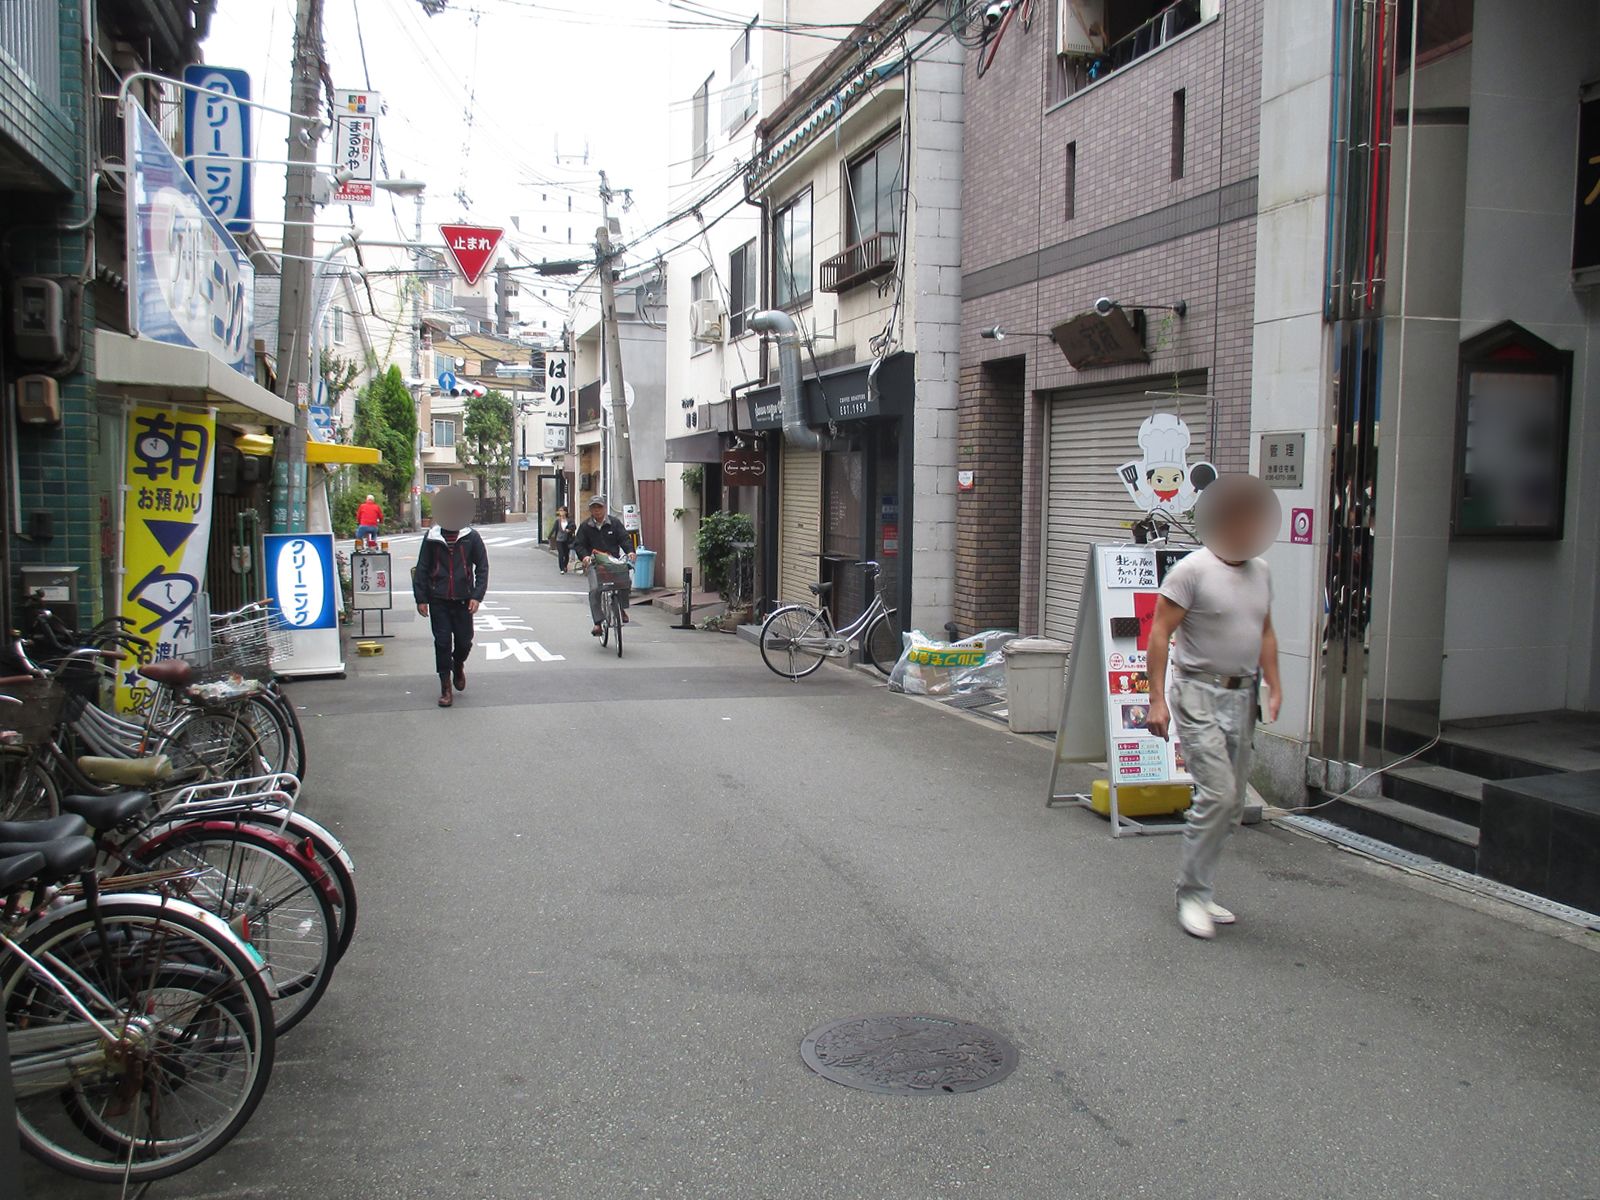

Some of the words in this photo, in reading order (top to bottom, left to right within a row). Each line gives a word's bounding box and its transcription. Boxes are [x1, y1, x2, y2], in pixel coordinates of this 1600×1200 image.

[206, 81, 233, 216] クリーニング
[453, 236, 492, 250] 止まれ
[548, 358, 567, 406] はり
[839, 402, 867, 416] EST.1959
[132, 413, 209, 484] 朝
[138, 486, 203, 514] お預かり
[292, 540, 310, 625] クリーニング
